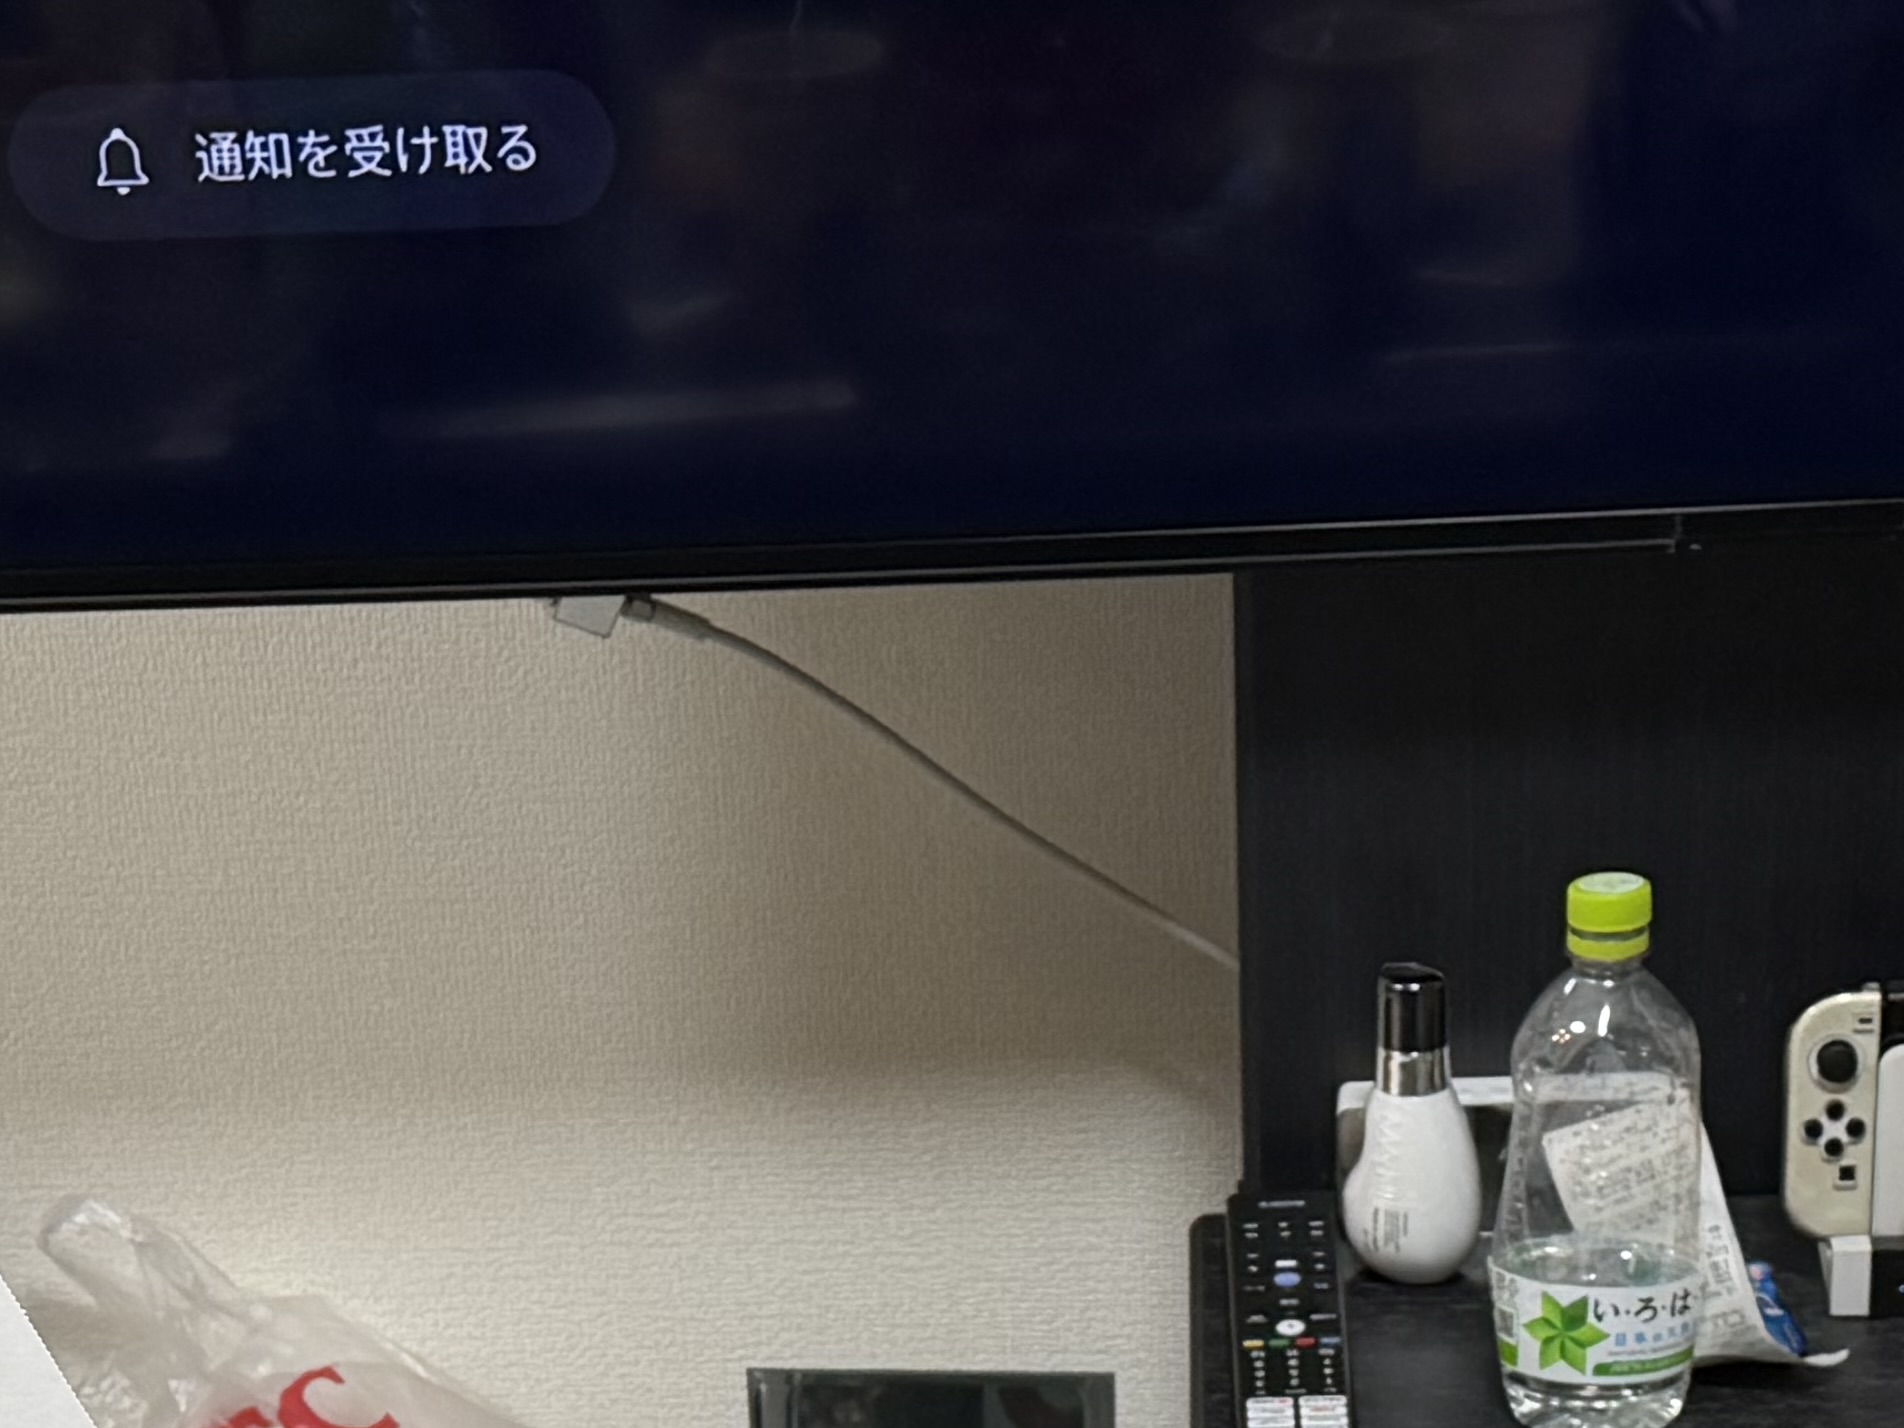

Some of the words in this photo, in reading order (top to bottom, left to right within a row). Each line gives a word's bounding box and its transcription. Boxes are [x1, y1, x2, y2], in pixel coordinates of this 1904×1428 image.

[195, 123, 538, 184] 通知を受け取る
